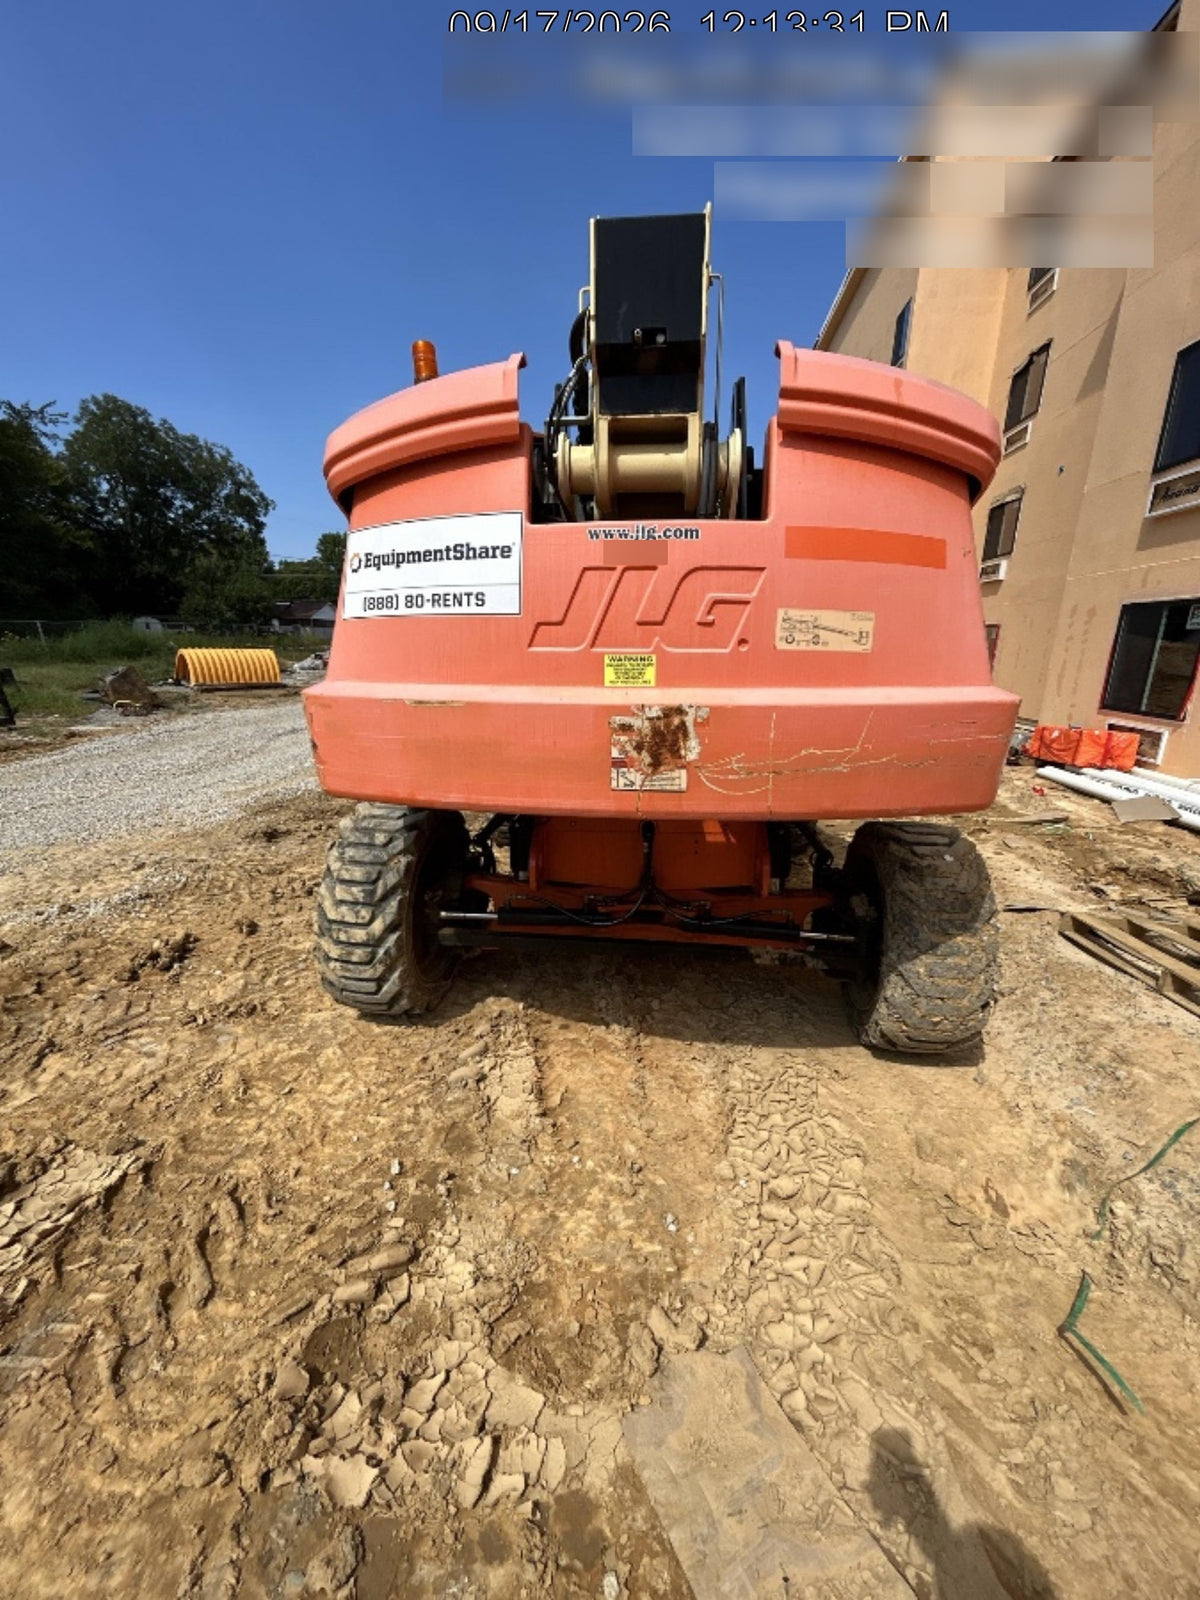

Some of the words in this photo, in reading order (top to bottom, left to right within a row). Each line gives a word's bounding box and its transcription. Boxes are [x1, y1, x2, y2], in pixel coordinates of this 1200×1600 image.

[588, 525, 700, 540] www.jlg.com
[363, 542, 512, 571] EquipmentShare
[363, 594, 399, 612] (888)
[405, 592, 485, 608] 80-RENTS
